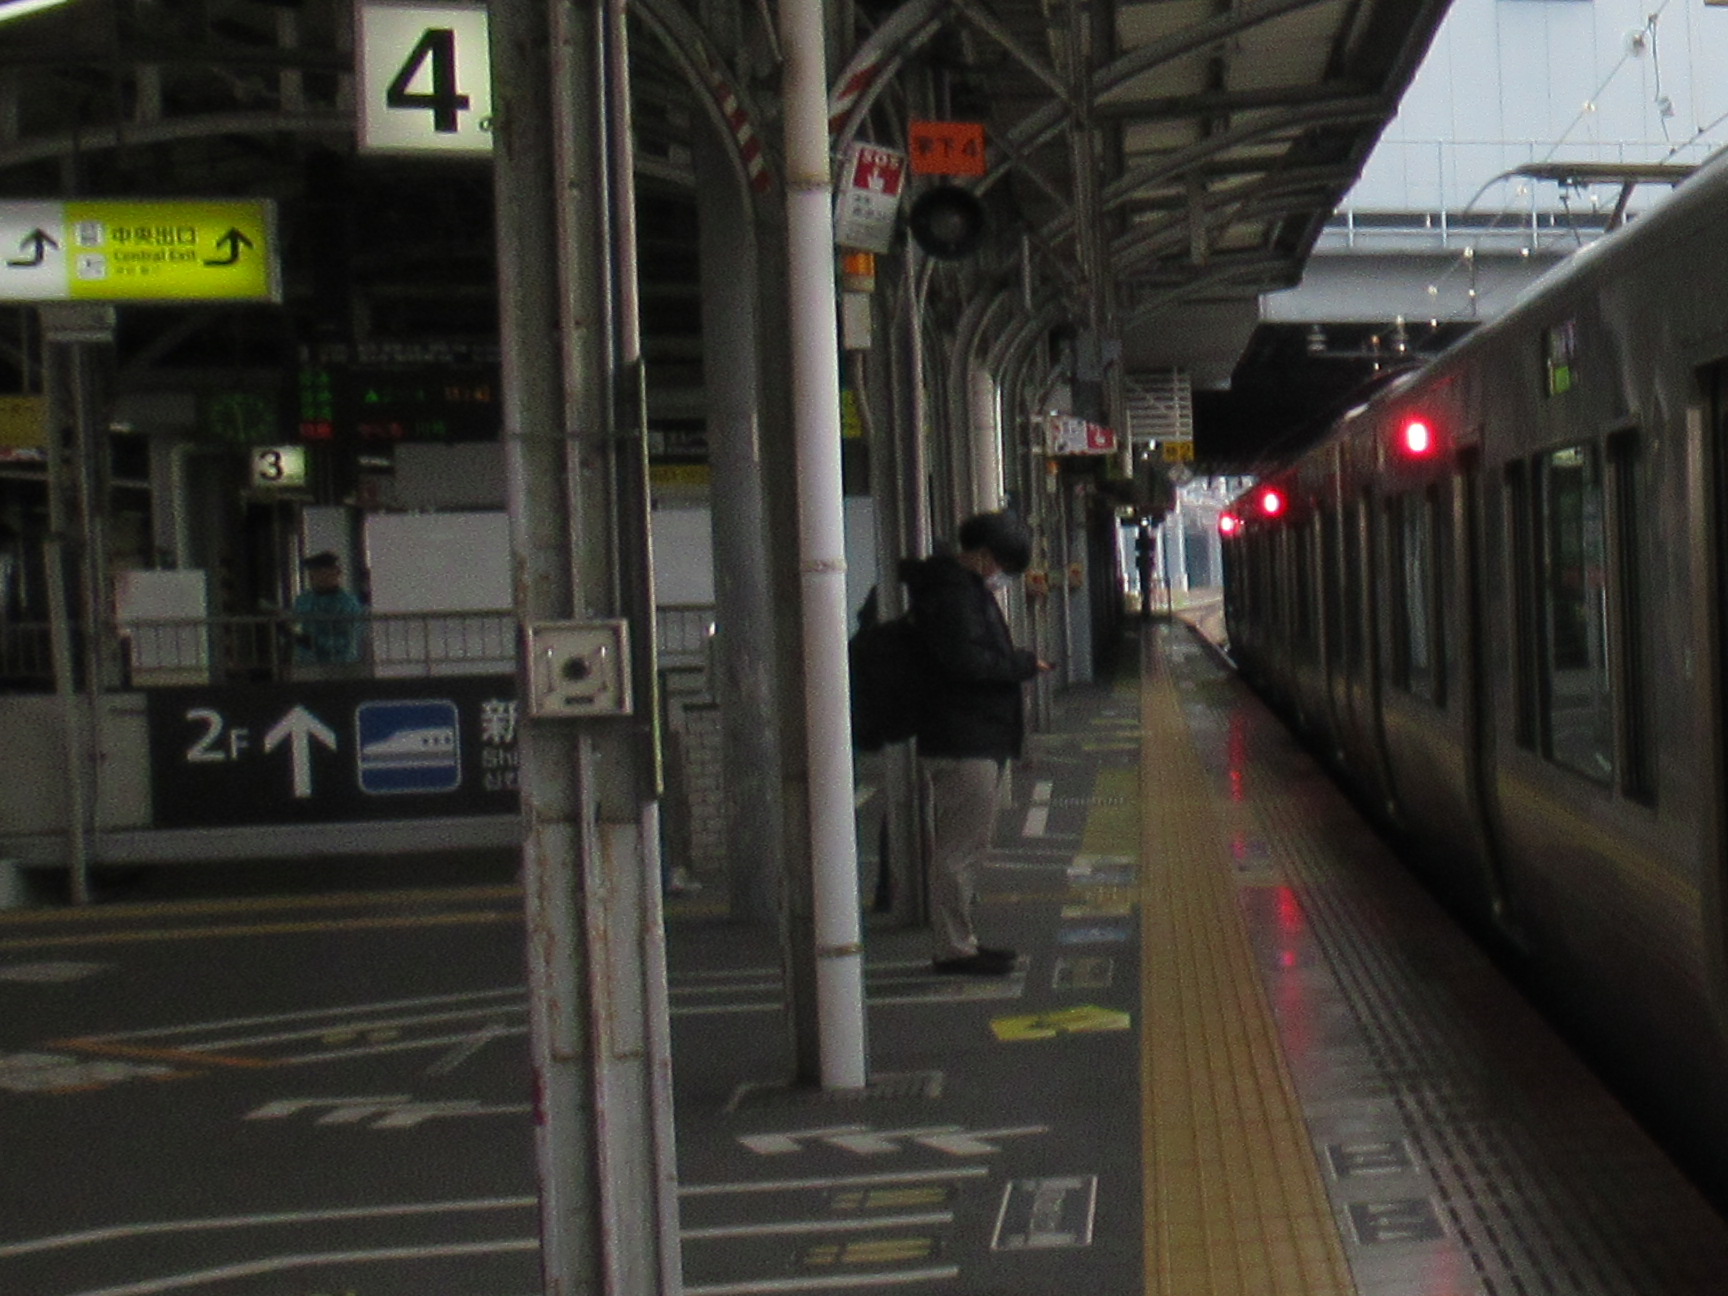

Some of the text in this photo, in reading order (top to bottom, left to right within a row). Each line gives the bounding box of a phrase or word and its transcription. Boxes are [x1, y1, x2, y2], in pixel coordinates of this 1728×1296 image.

[386, 28, 470, 133] 4
[258, 449, 284, 482] 3
[186, 707, 249, 763] 2F
